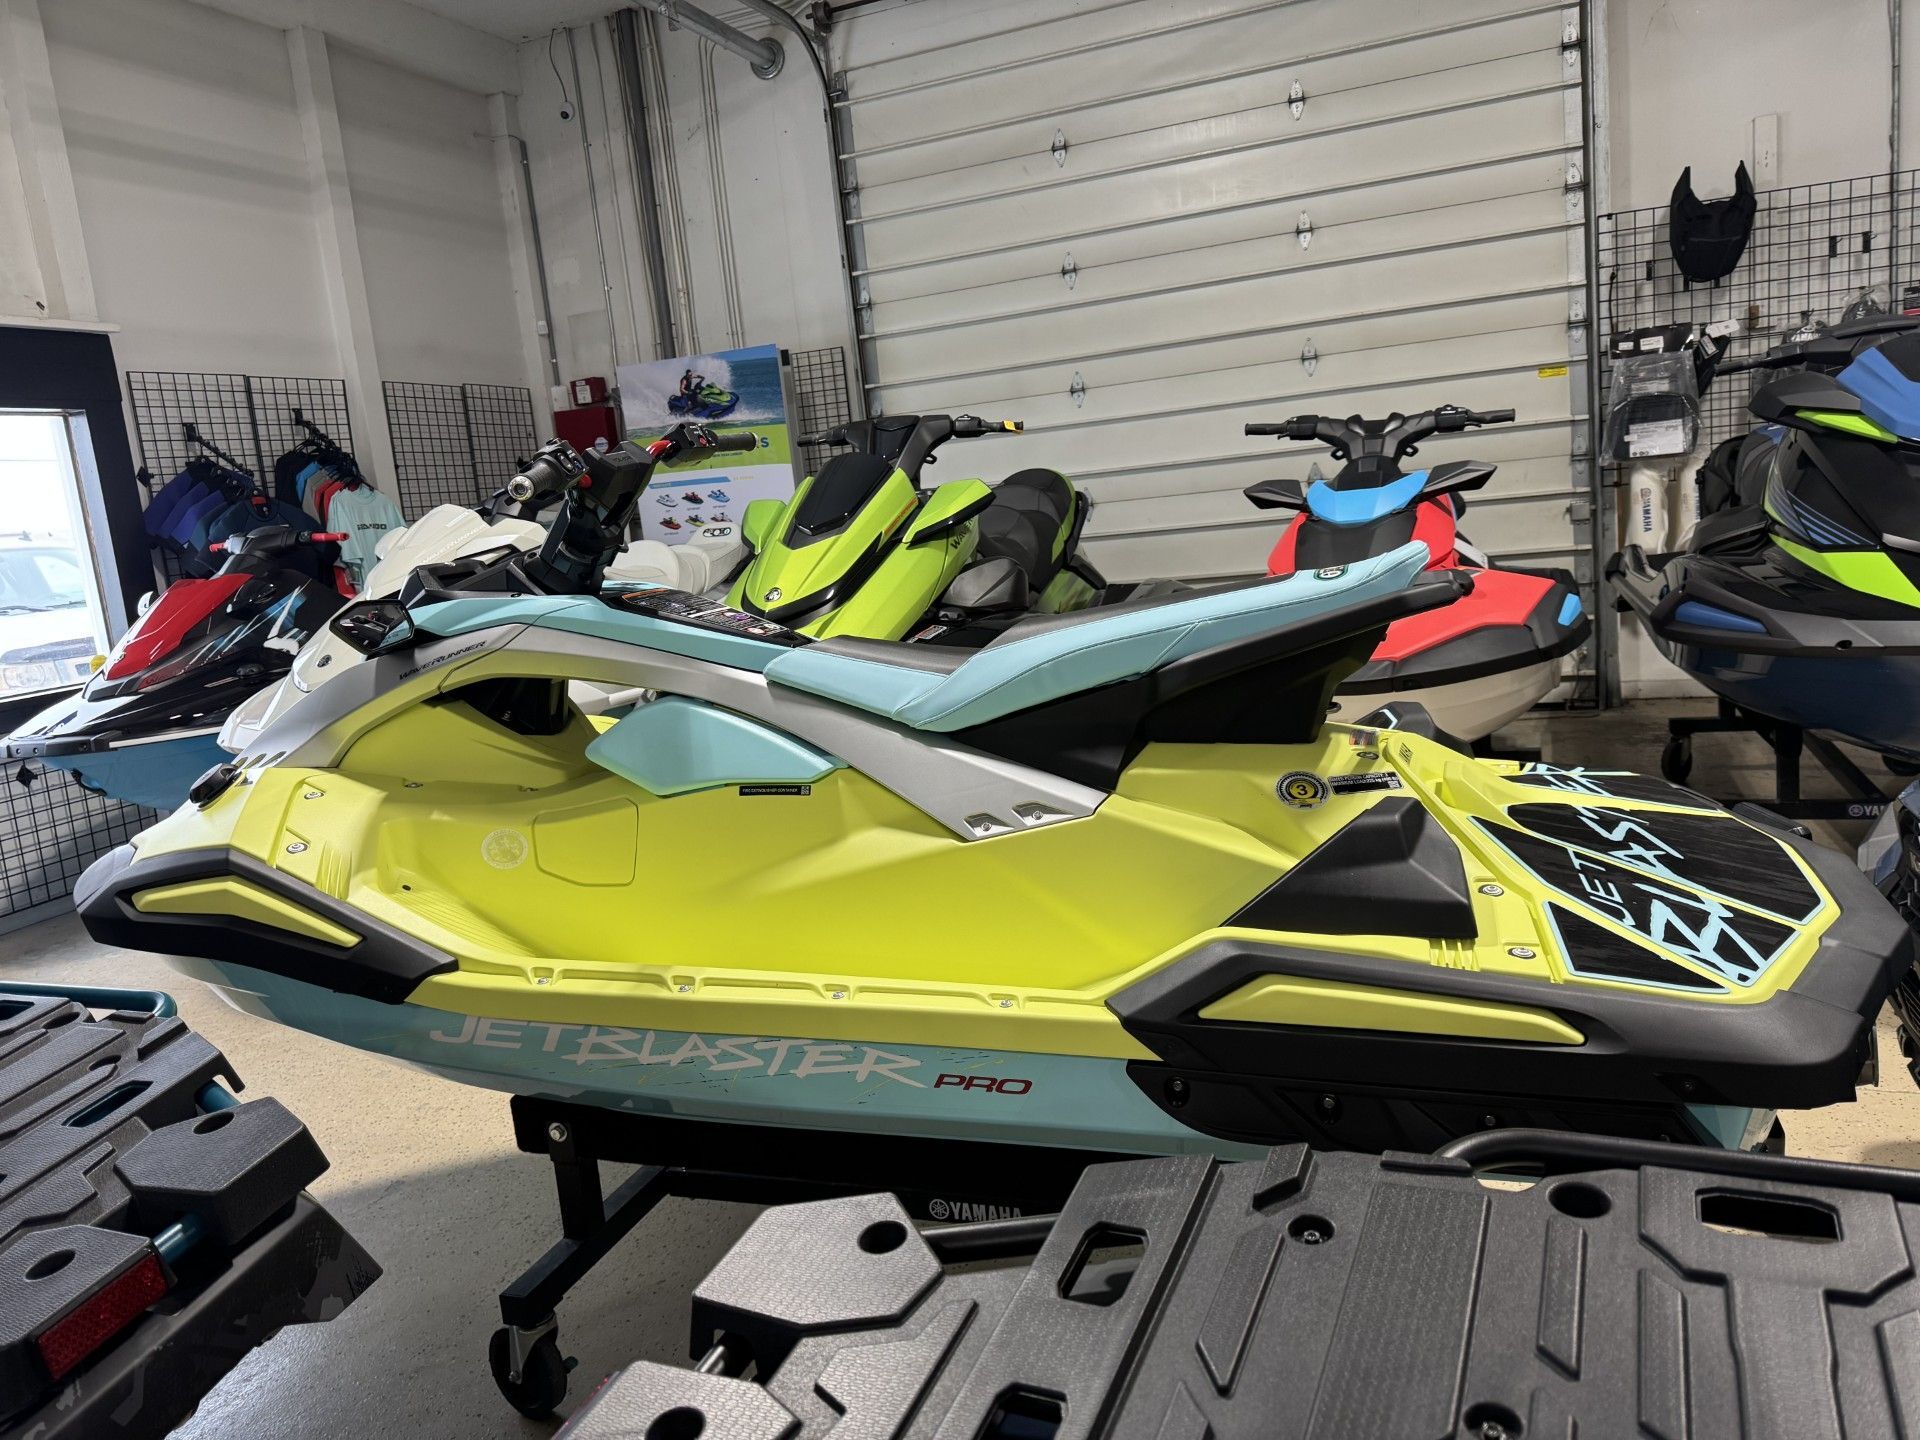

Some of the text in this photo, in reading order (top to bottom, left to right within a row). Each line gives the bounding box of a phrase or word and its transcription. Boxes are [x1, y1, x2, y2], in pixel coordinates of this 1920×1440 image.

[1642, 497, 1652, 533] YAMAHA
[399, 640, 487, 680] WAVERUNNER
[1296, 784, 1308, 796] 3
[1566, 848, 1636, 926] JET
[934, 1073, 1033, 1096] PRO
[950, 1201, 1022, 1222] YAMAHA
